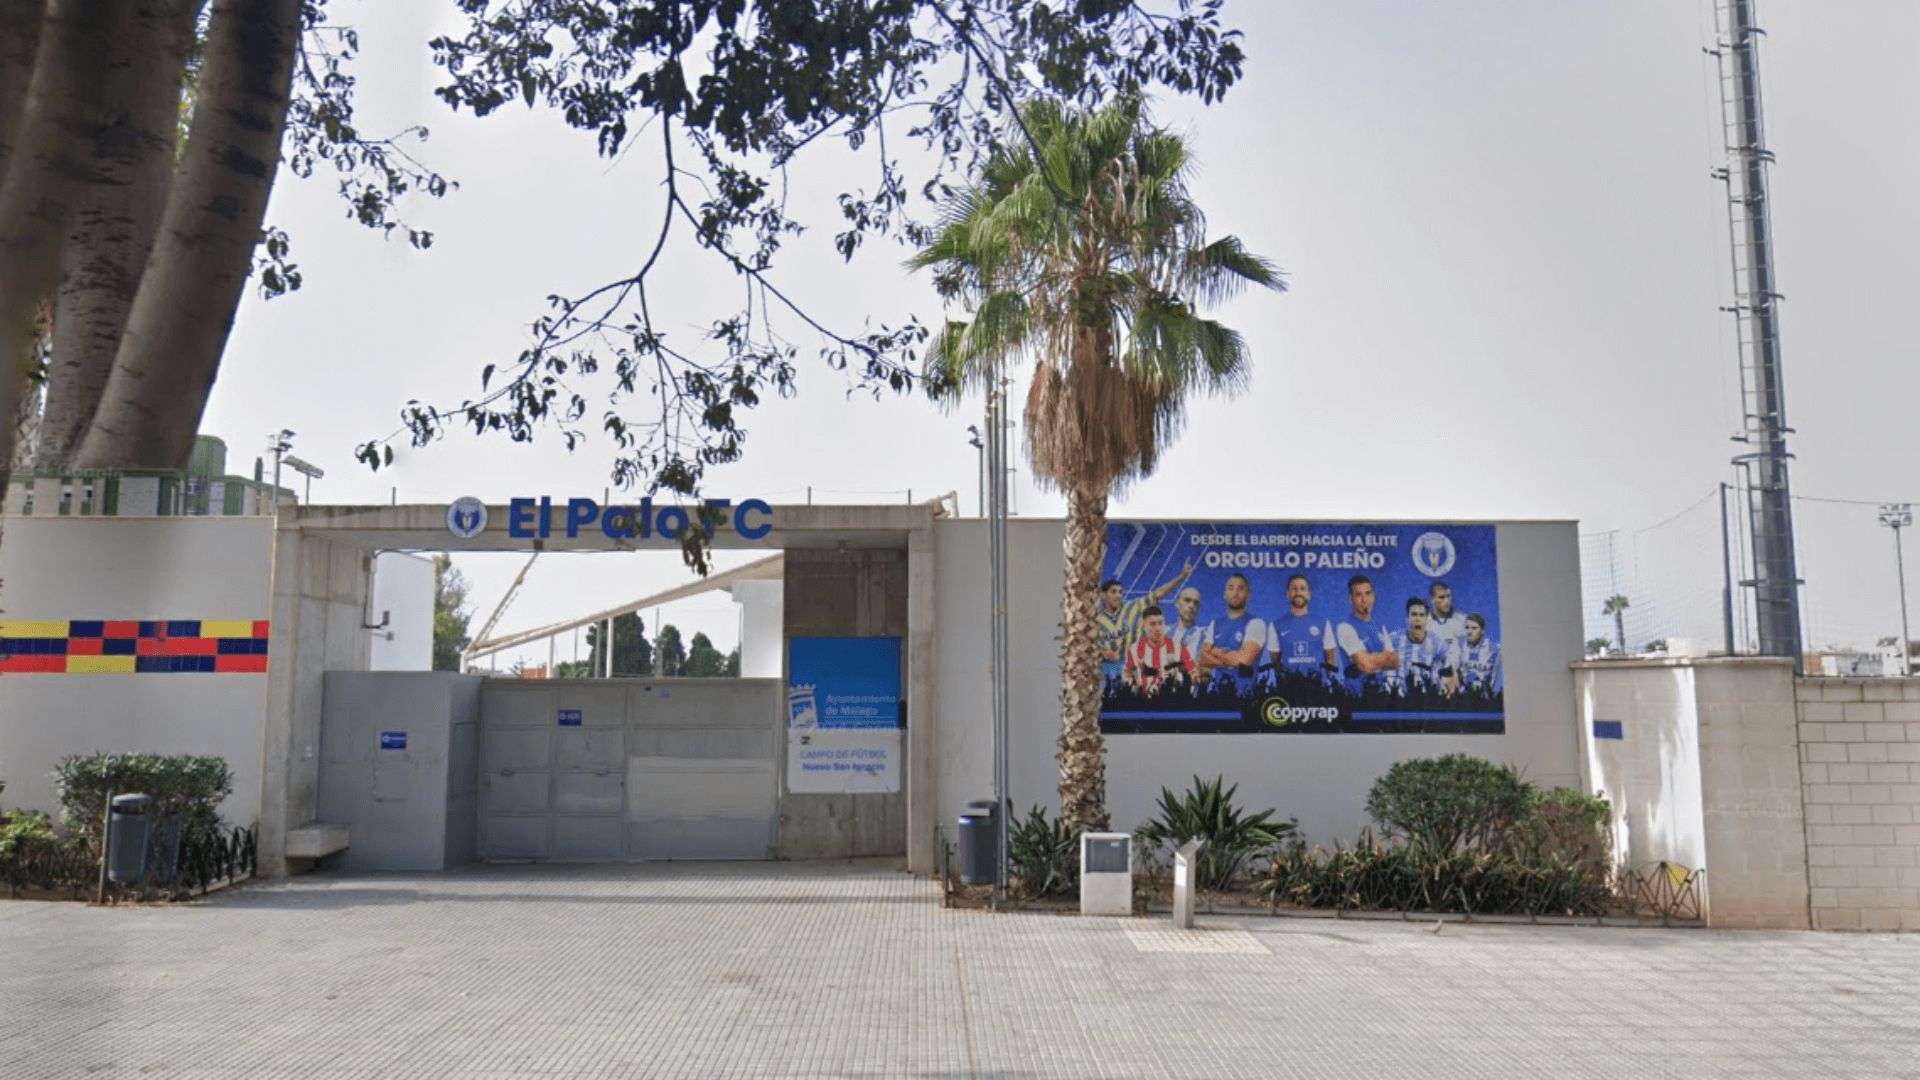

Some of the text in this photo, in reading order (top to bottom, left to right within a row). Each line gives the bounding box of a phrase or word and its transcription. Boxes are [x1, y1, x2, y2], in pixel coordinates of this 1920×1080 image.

[509, 495, 551, 539] El
[567, 497, 690, 540] Palo
[1190, 531, 1398, 546] DESDE EL BARRIO HACIA LA ÉLITE
[1204, 547, 1386, 569] ORGULLO PALEÑO
[800, 750, 834, 759] CAMPO
[835, 750, 849, 759] DE
[802, 763, 832, 772] Nuevo
[833, 762, 850, 772] San
